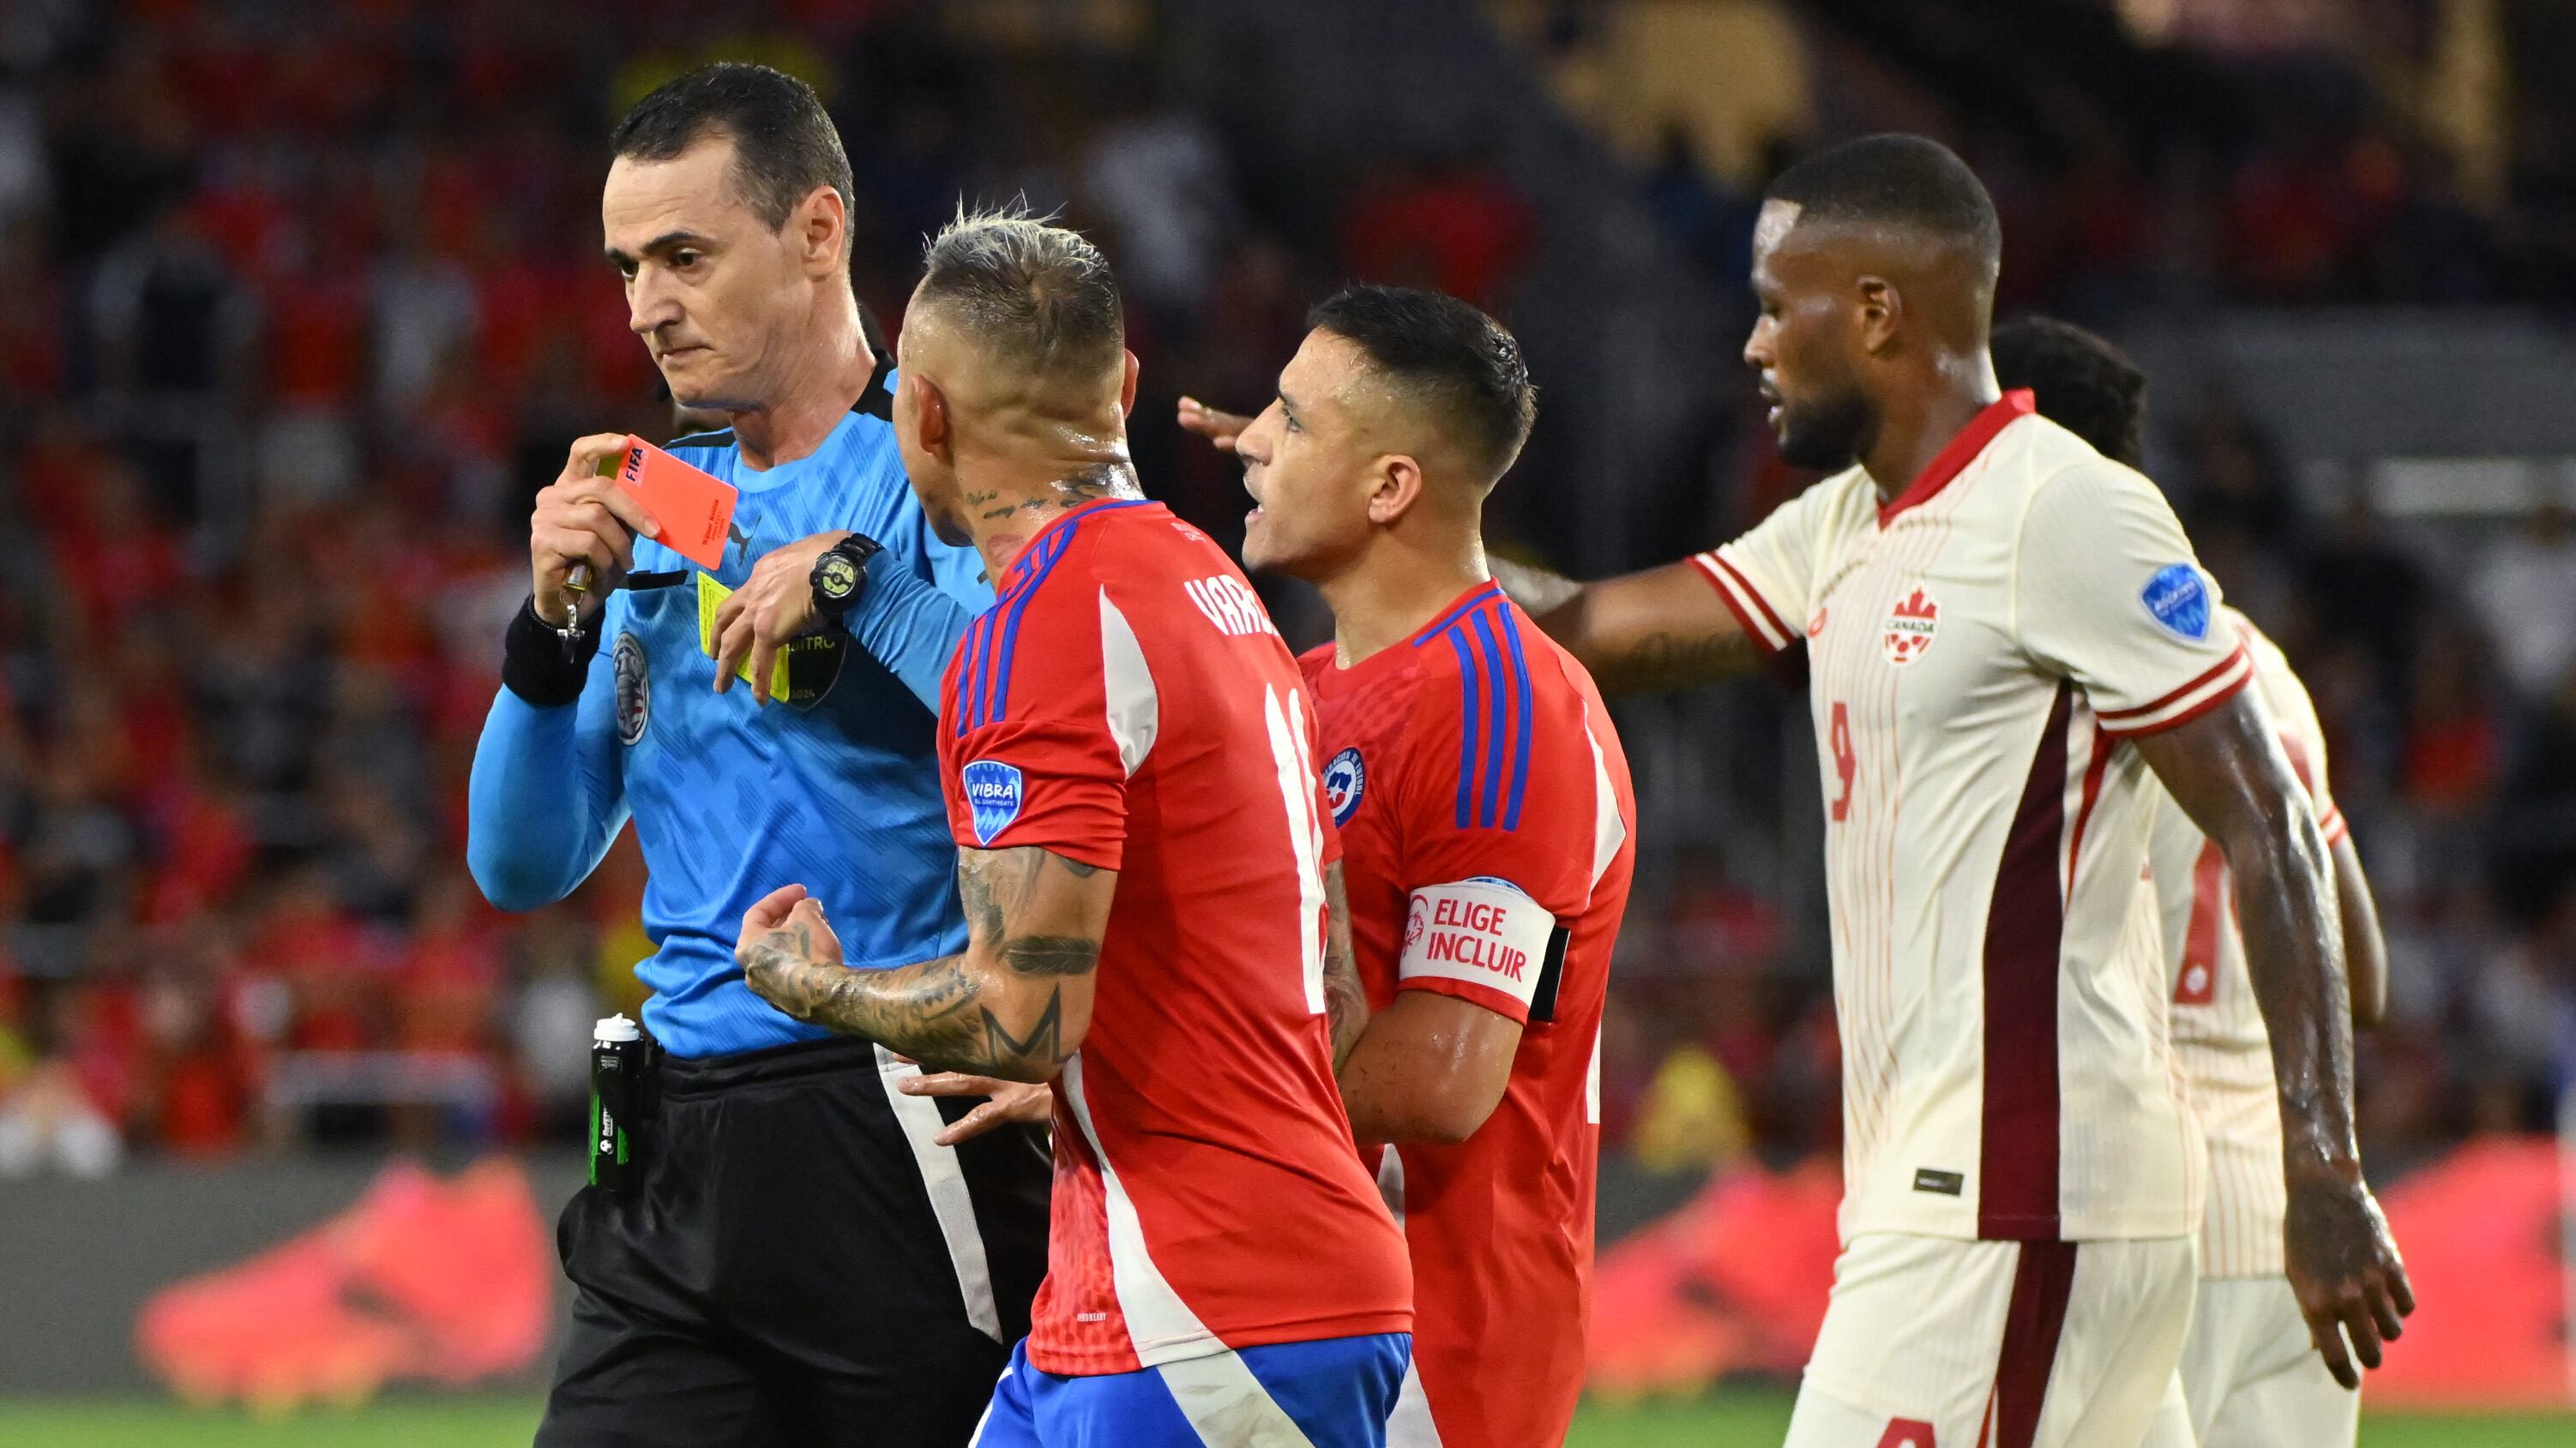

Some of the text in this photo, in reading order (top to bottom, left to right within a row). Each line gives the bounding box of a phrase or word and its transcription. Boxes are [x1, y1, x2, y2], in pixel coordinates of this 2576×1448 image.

[625, 446, 644, 483] FIFA
[1886, 619, 1935, 634] CANADA
[1831, 700, 1856, 823] 9
[972, 783, 1014, 799] VIBRA
[1434, 898, 1507, 936] ELIGE
[1427, 932, 1526, 982] INCLUIR
